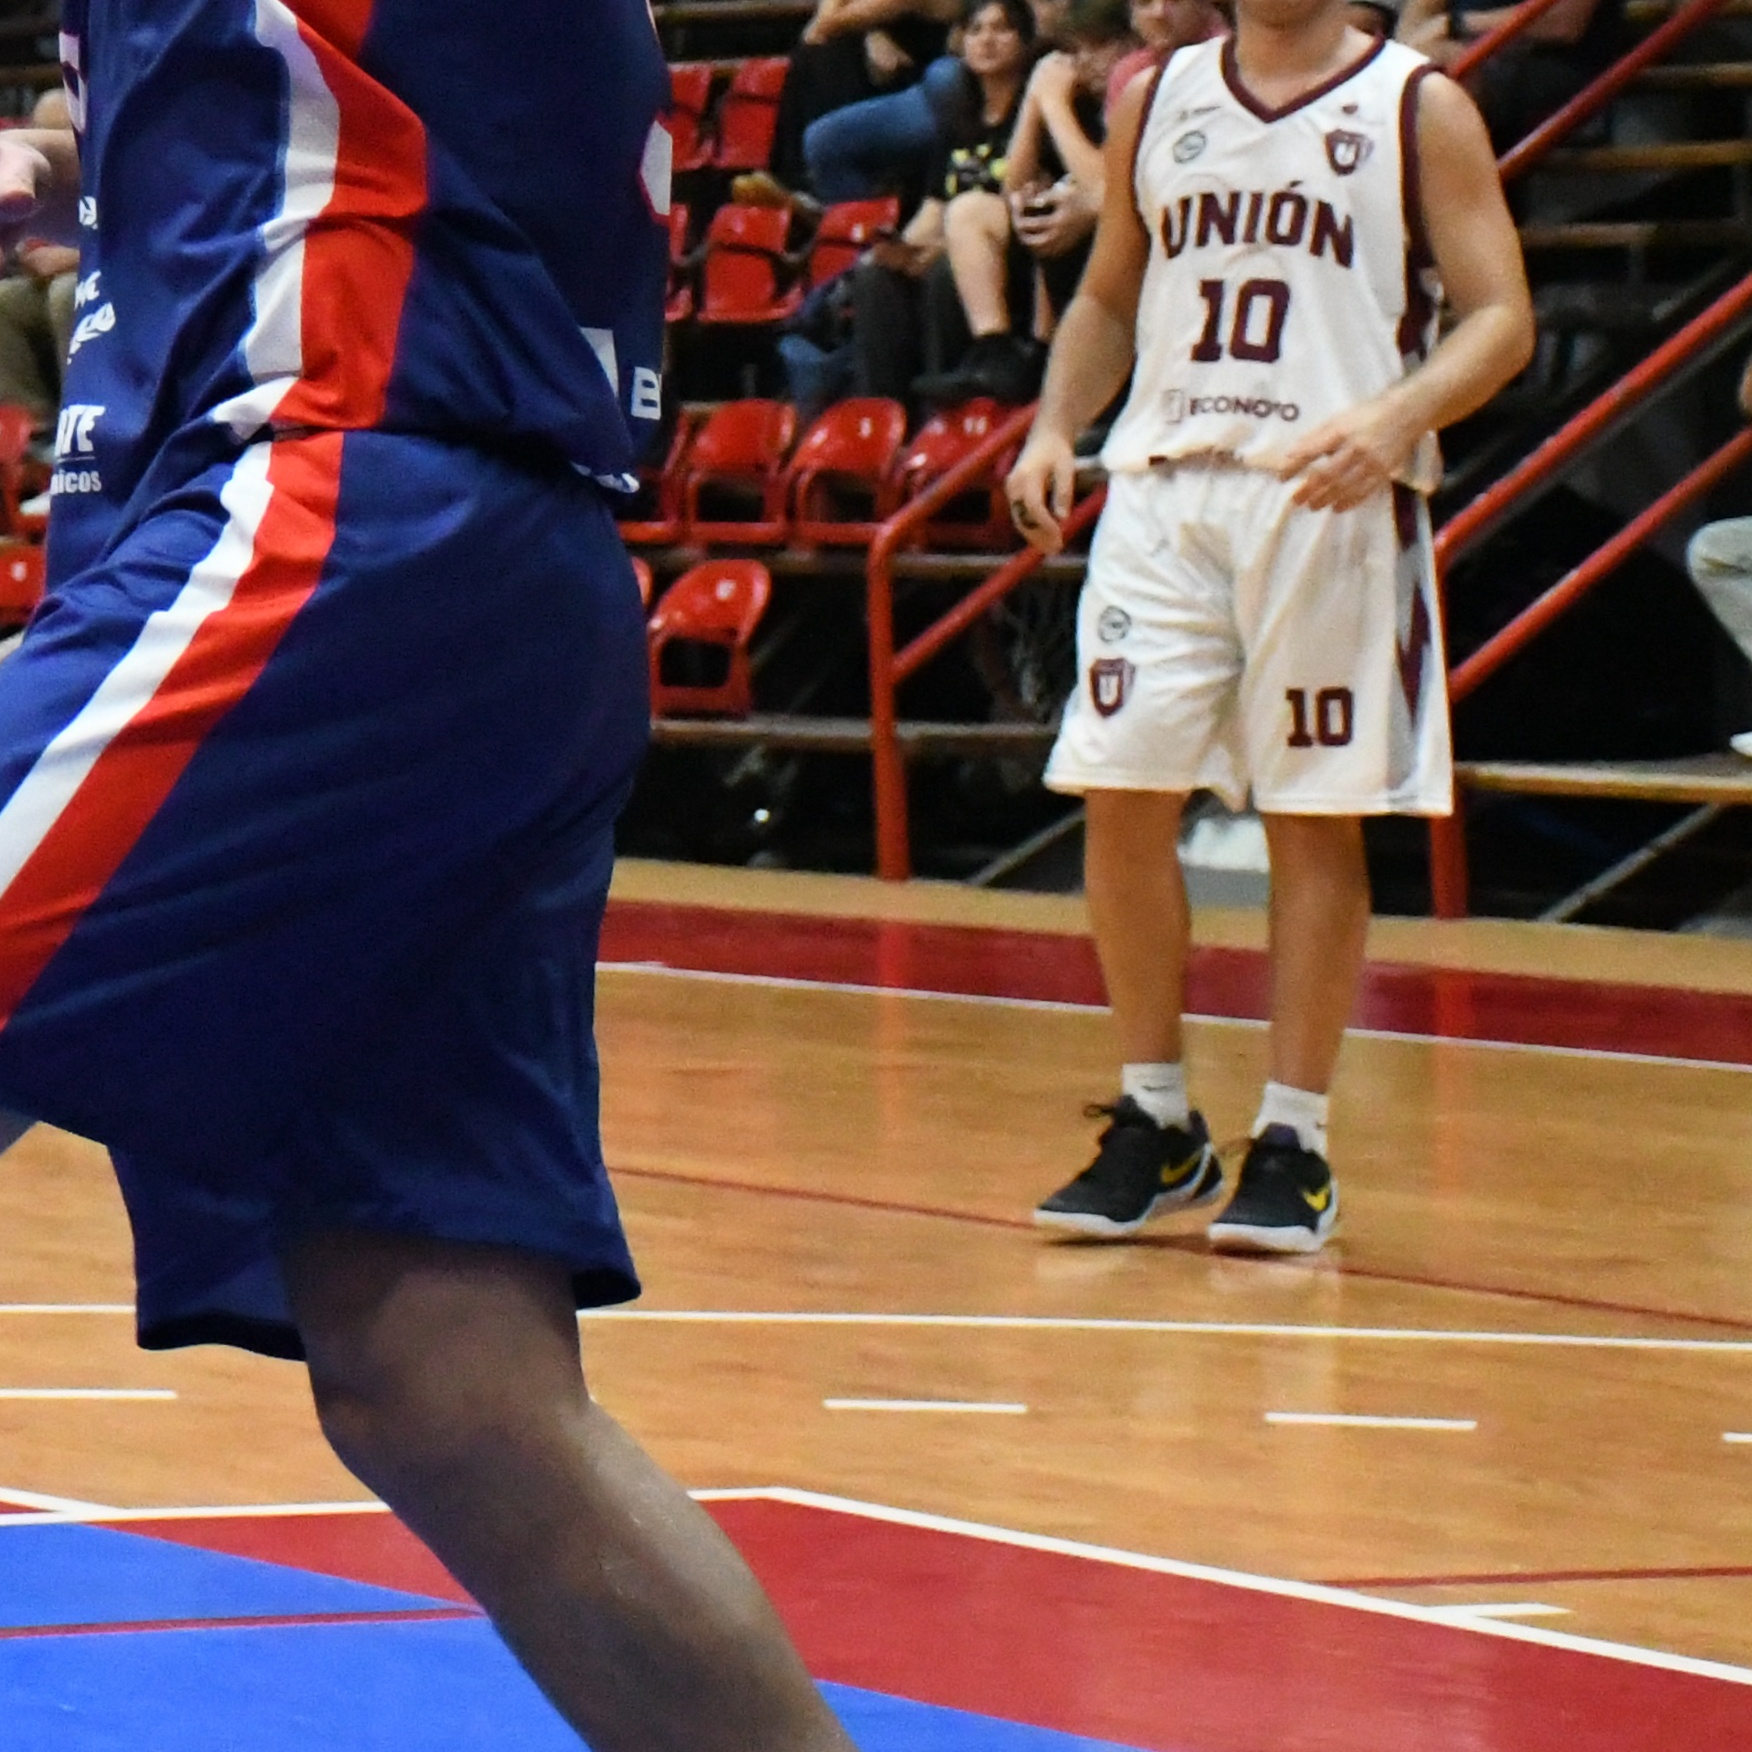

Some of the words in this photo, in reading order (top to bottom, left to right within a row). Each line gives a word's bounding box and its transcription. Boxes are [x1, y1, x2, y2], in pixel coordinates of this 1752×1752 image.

[1160, 179, 1356, 270] UNIÓN
[1190, 278, 1291, 364] 10
[1285, 685, 1355, 749] 10
